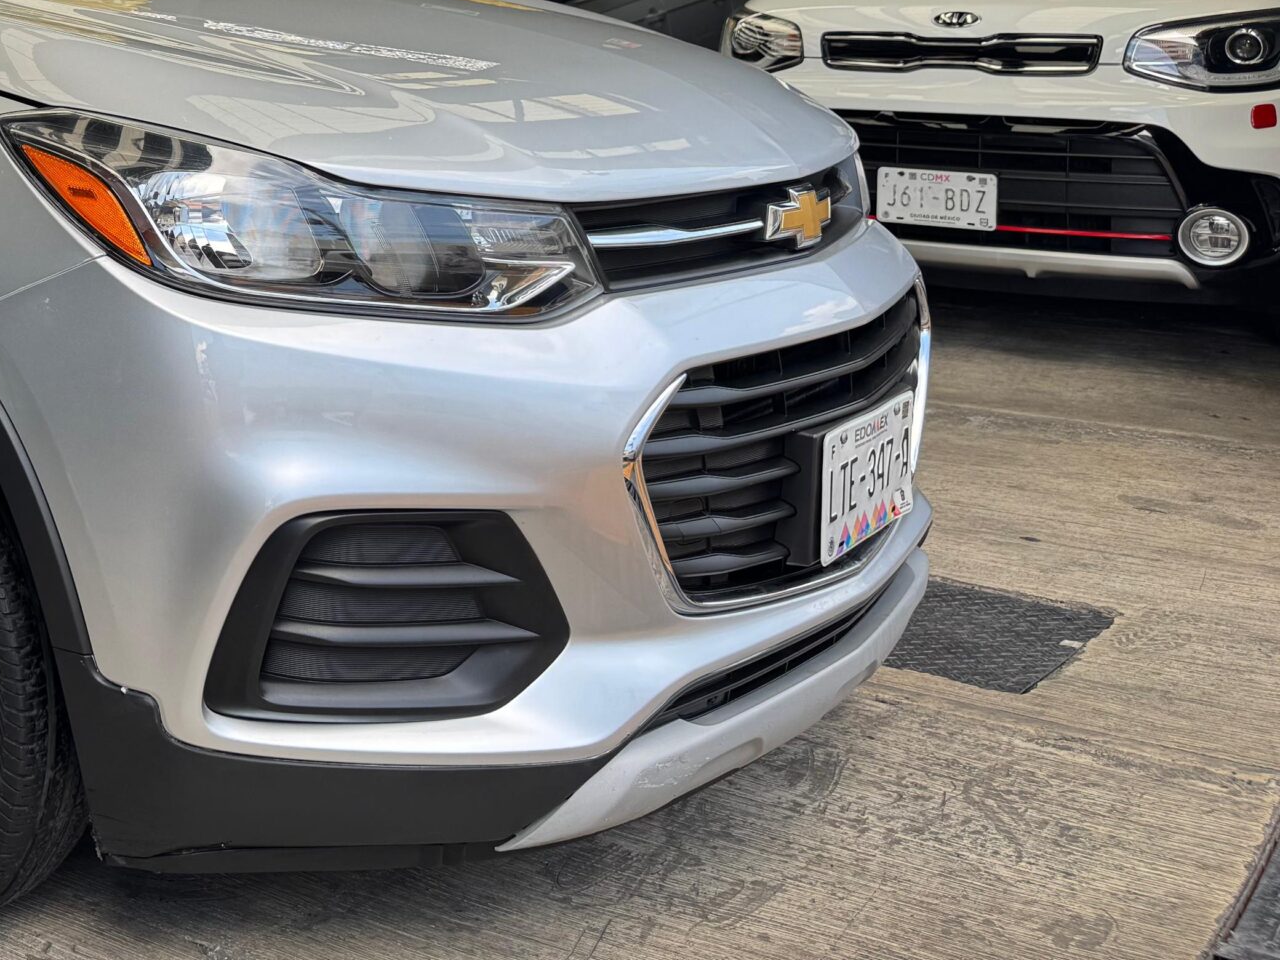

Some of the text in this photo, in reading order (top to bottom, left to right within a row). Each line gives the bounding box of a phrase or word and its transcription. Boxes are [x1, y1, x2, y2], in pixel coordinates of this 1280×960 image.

[939, 12, 972, 23] KIA
[920, 172, 951, 182] CDMX
[830, 427, 909, 523] LTE-347-A
